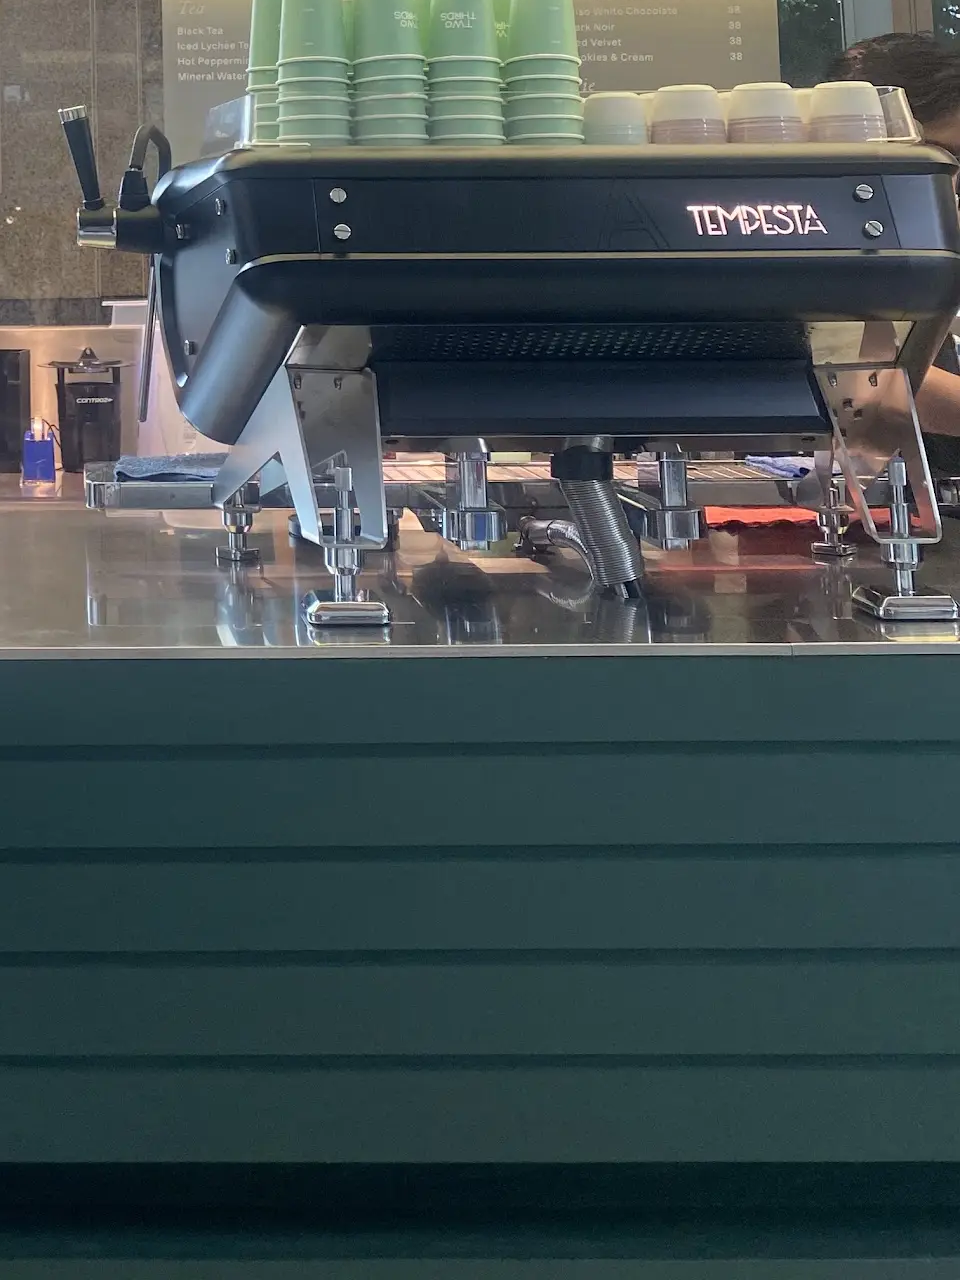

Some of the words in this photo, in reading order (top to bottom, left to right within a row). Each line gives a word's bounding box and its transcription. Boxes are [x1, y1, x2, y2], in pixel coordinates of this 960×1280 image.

[178, 1, 205, 15] Tea
[626, 7, 678, 15] Chocolate
[440, 11, 476, 21] THRDS
[445, 20, 472, 28] TWO
[575, 23, 591, 32] ark
[594, 23, 615, 31] Noir
[728, 22, 741, 30] 38
[177, 27, 204, 35] Black
[207, 27, 223, 35] Tea
[576, 38, 588, 47] ed
[590, 38, 621, 47] Velvet
[729, 37, 742, 45] 38
[177, 42, 198, 51] Iced
[201, 41, 236, 53] Lychee
[238, 41, 249, 50] Te
[621, 53, 654, 62] Cream
[730, 53, 743, 61] 38
[177, 58, 195, 66] Hot
[178, 73, 214, 82] Mineral
[217, 72, 246, 81] Water
[687, 205, 828, 236] TEMPESTA
